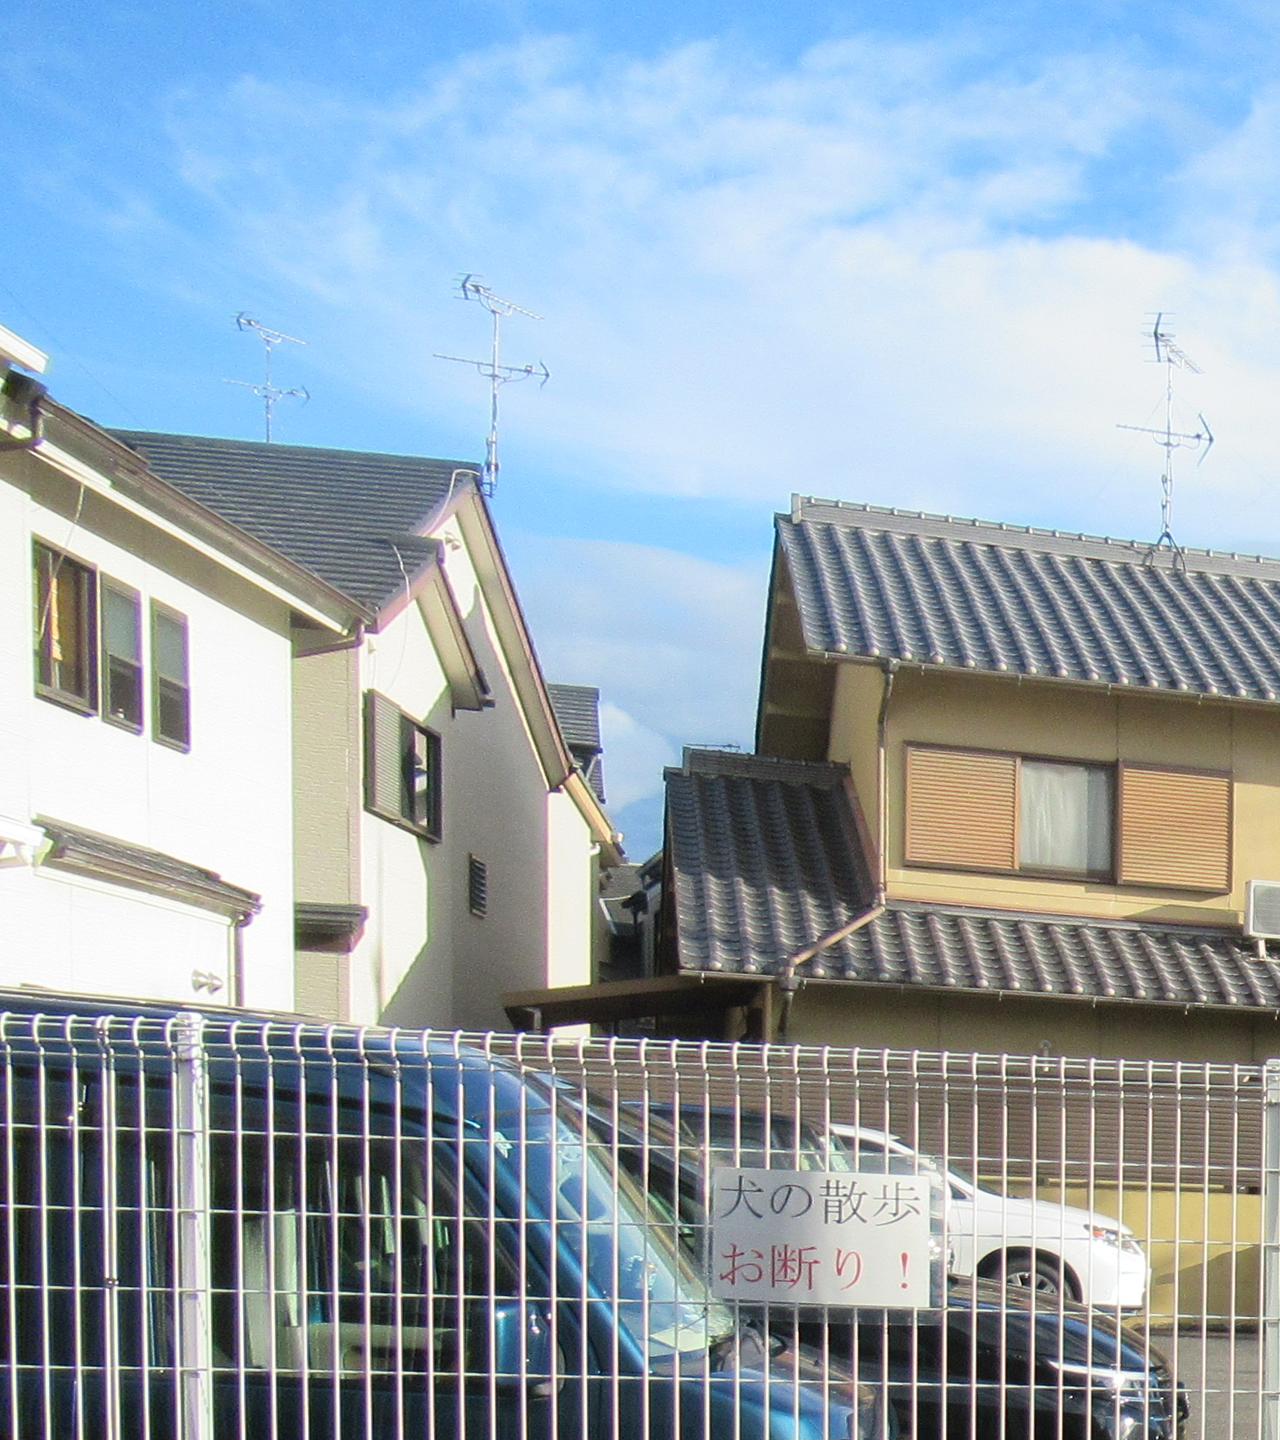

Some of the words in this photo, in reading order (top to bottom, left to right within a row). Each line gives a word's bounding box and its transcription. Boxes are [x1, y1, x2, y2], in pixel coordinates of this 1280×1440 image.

[719, 1174, 921, 1227] 犬の散歩
[719, 1243, 909, 1291] お断り！
